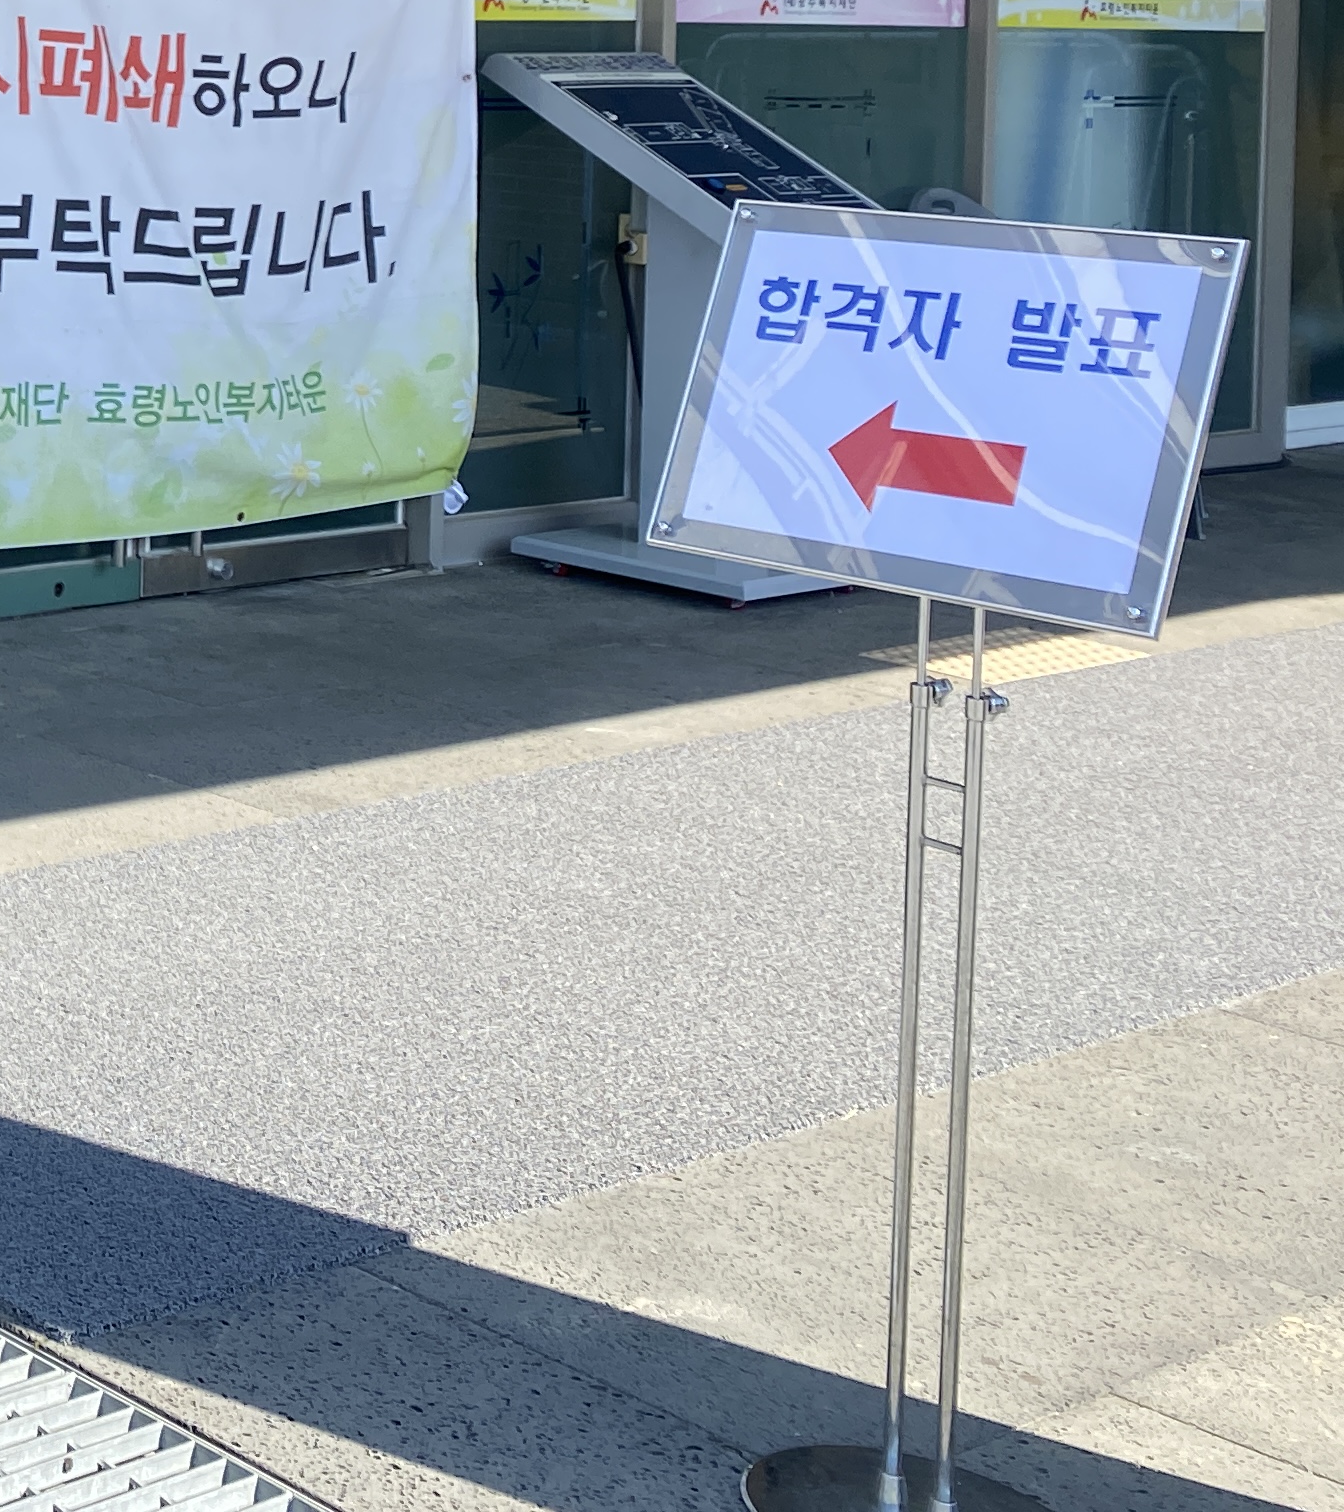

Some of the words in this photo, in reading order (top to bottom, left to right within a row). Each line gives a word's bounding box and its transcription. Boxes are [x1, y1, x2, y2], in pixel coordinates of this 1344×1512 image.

[754, 275, 963, 361] 합격자
[1005, 299, 1162, 378] 발표
[87, 370, 327, 427] 효령노인복지타운
